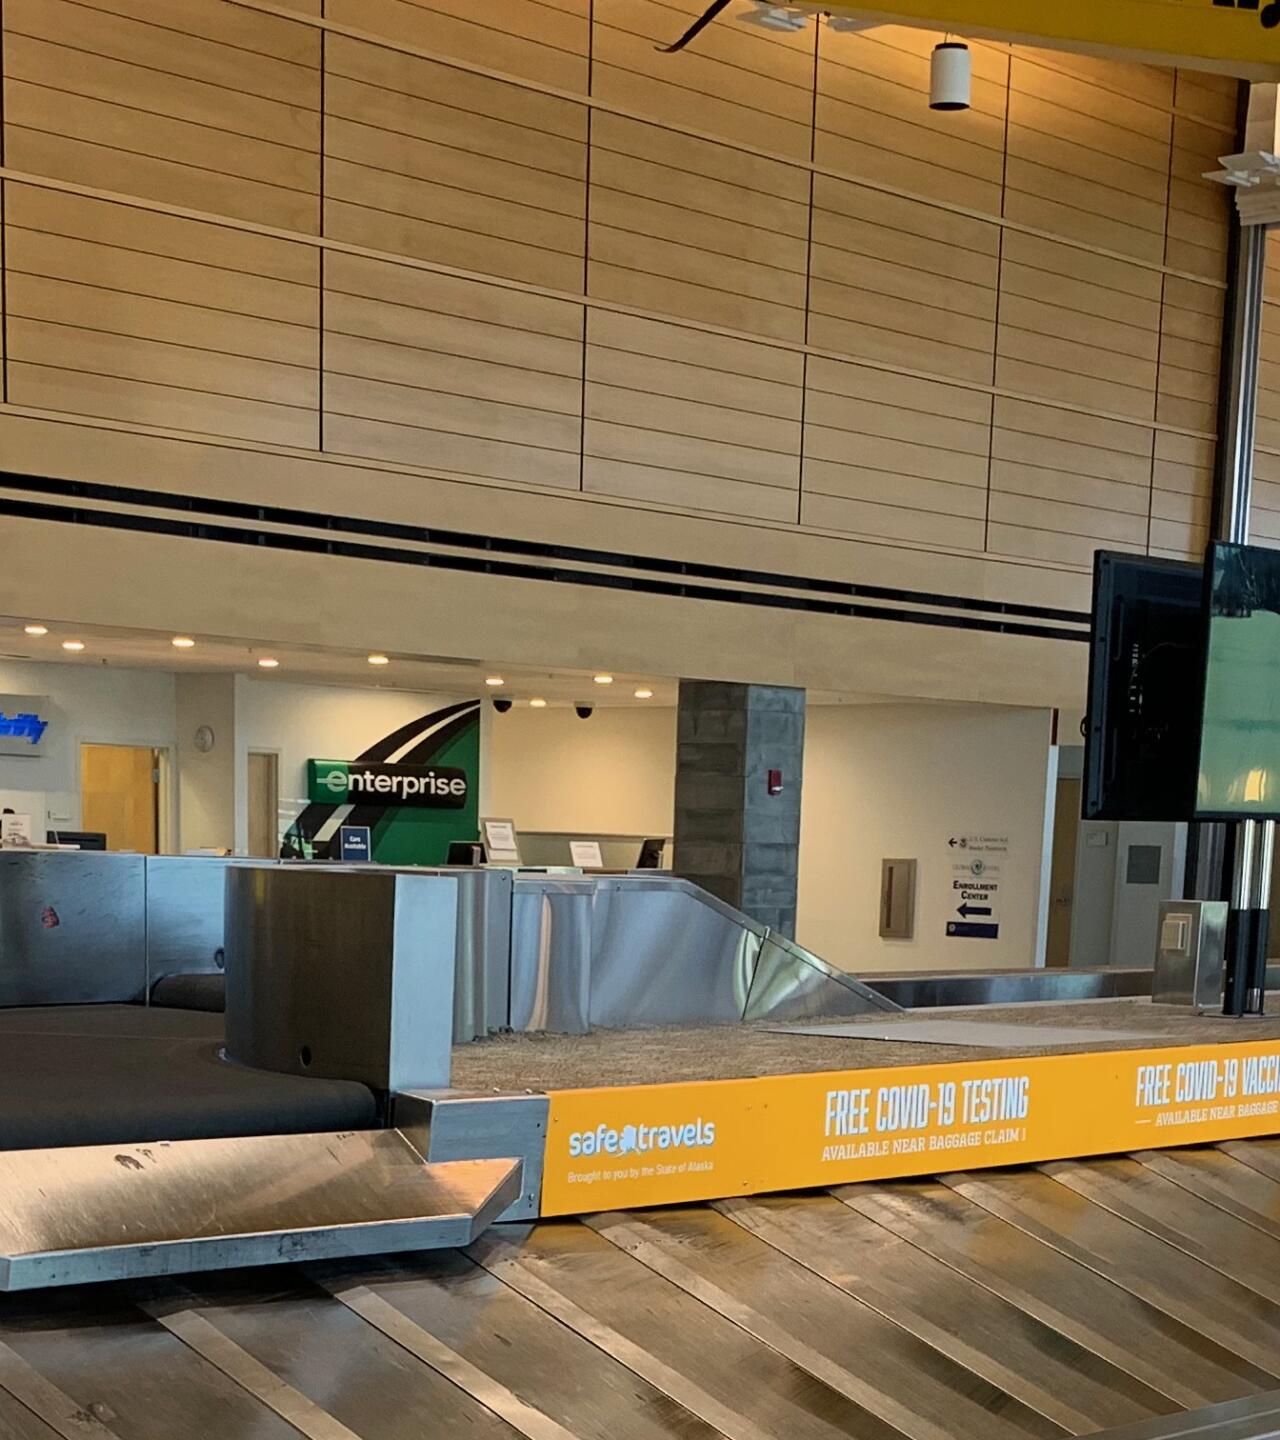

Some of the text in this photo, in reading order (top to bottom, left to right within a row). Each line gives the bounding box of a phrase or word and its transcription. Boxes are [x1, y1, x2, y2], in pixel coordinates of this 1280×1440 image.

[317, 770, 467, 799] enterprise
[961, 891, 989, 900] CENTER
[1136, 1064, 1172, 1107] FREE
[1176, 1058, 1239, 1103] COVID-19
[824, 1076, 1030, 1137] FREE COVID-19 TESTING
[1155, 1108, 1207, 1127] AVAILABLE
[1210, 1105, 1236, 1120] NEAR
[1238, 1100, 1278, 1117] BAGGAGE
[569, 1117, 716, 1157] safe travels
[821, 1140, 890, 1162] AVAILABLE
[892, 1136, 926, 1155] NEAR
[928, 1131, 982, 1151] BAGGAGE
[983, 1127, 1020, 1145] CLAIM
[567, 1160, 714, 1185] Brought to you by the State of Alaska
